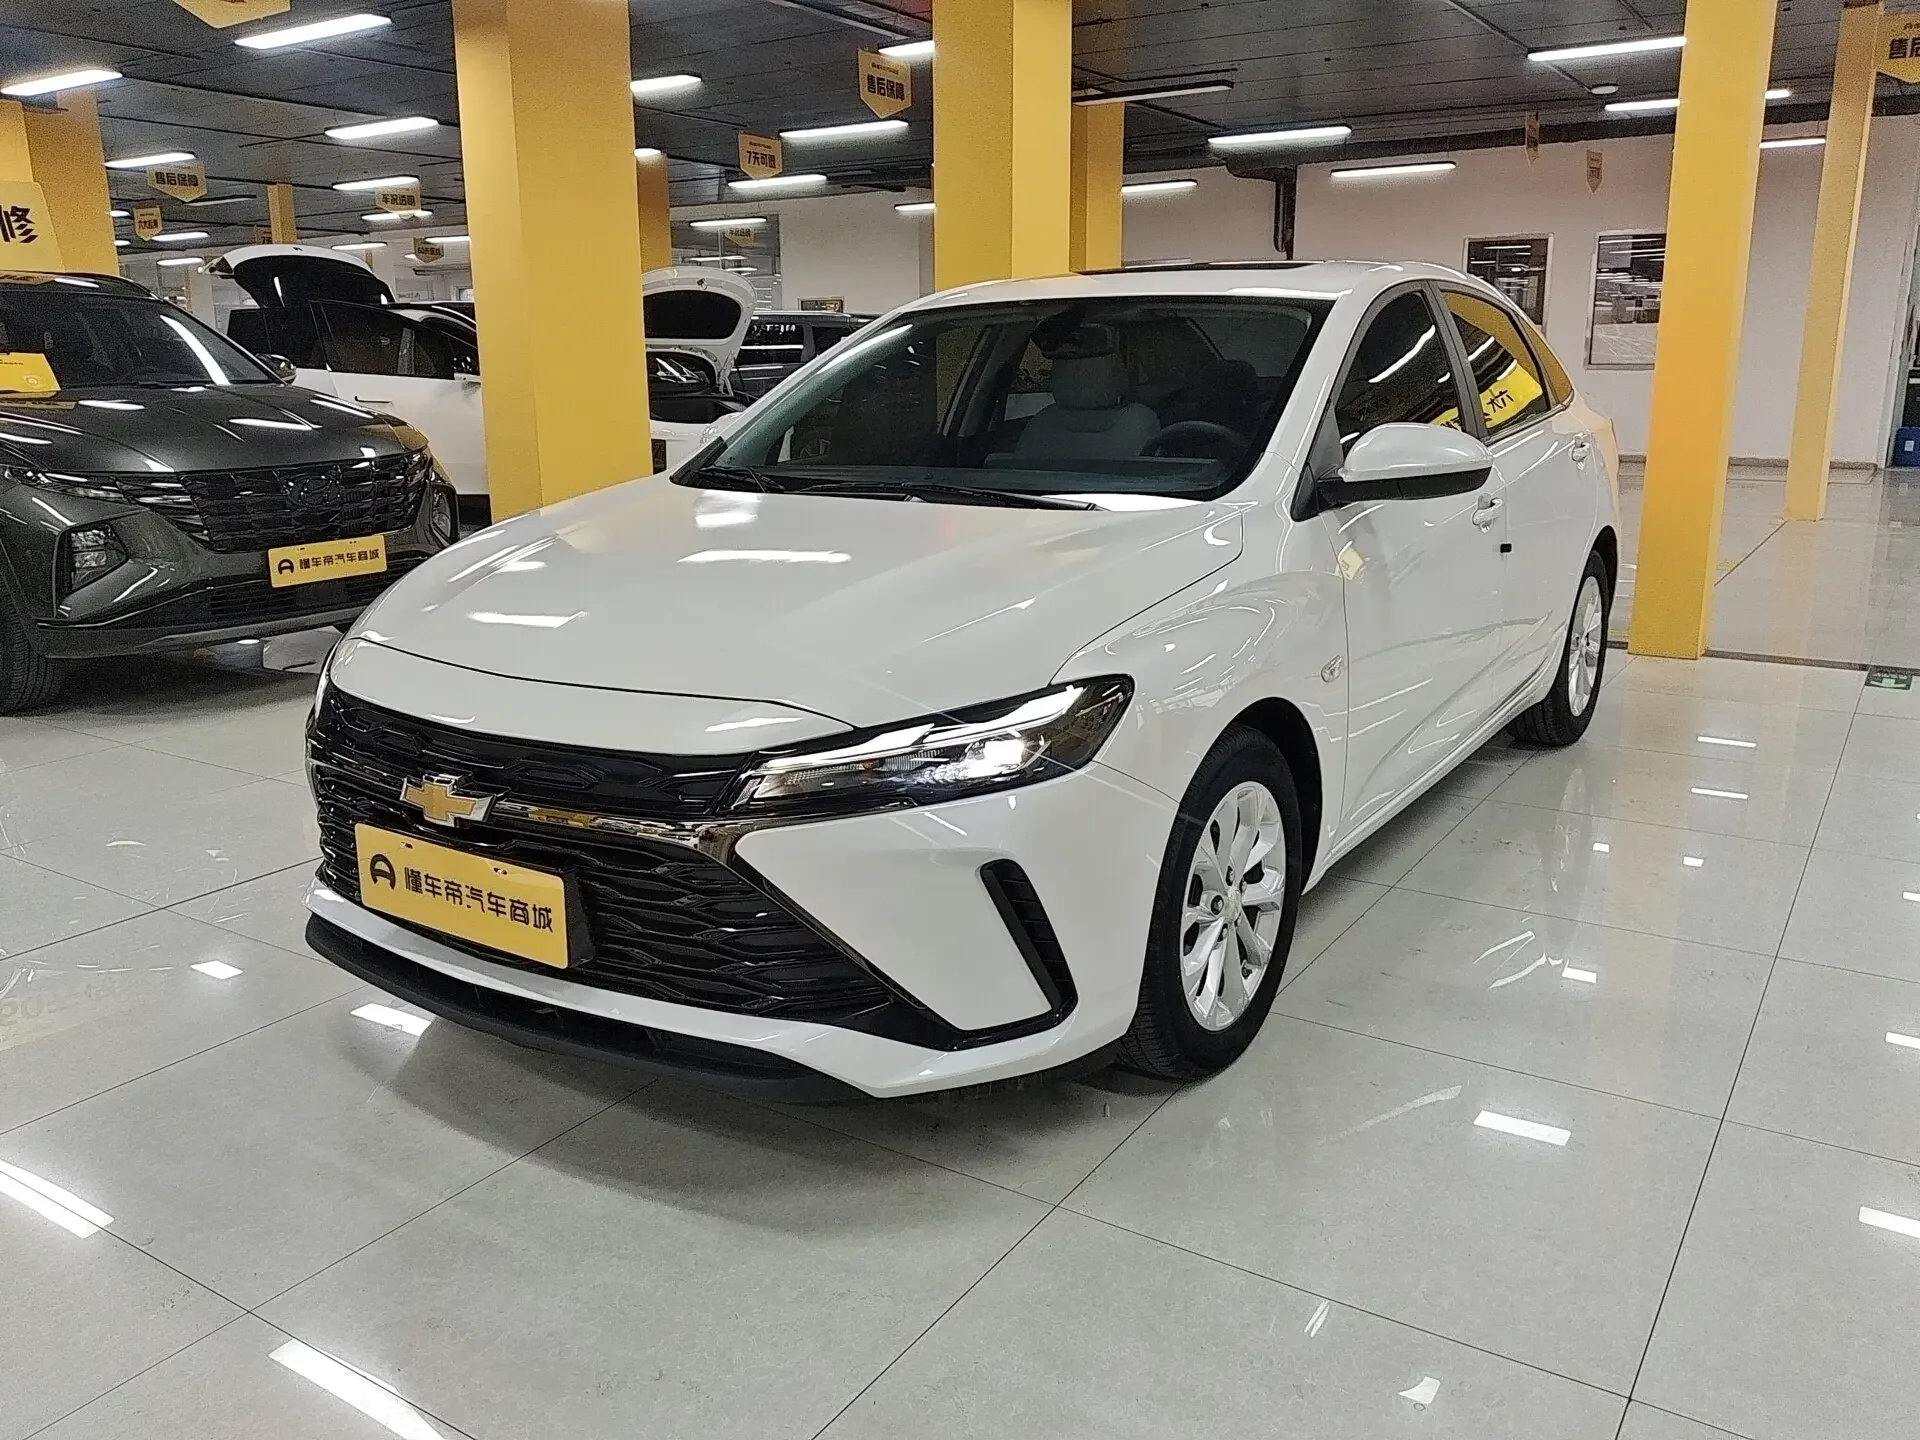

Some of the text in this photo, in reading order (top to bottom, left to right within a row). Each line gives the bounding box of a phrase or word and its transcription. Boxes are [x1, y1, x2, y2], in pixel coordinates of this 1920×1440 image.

[867, 73, 905, 101] 售后保障
[746, 150, 776, 169] 7天可退
[299, 548, 380, 570] 懂车帝汽车商城
[404, 866, 554, 933] 懂车帝汽车商城
